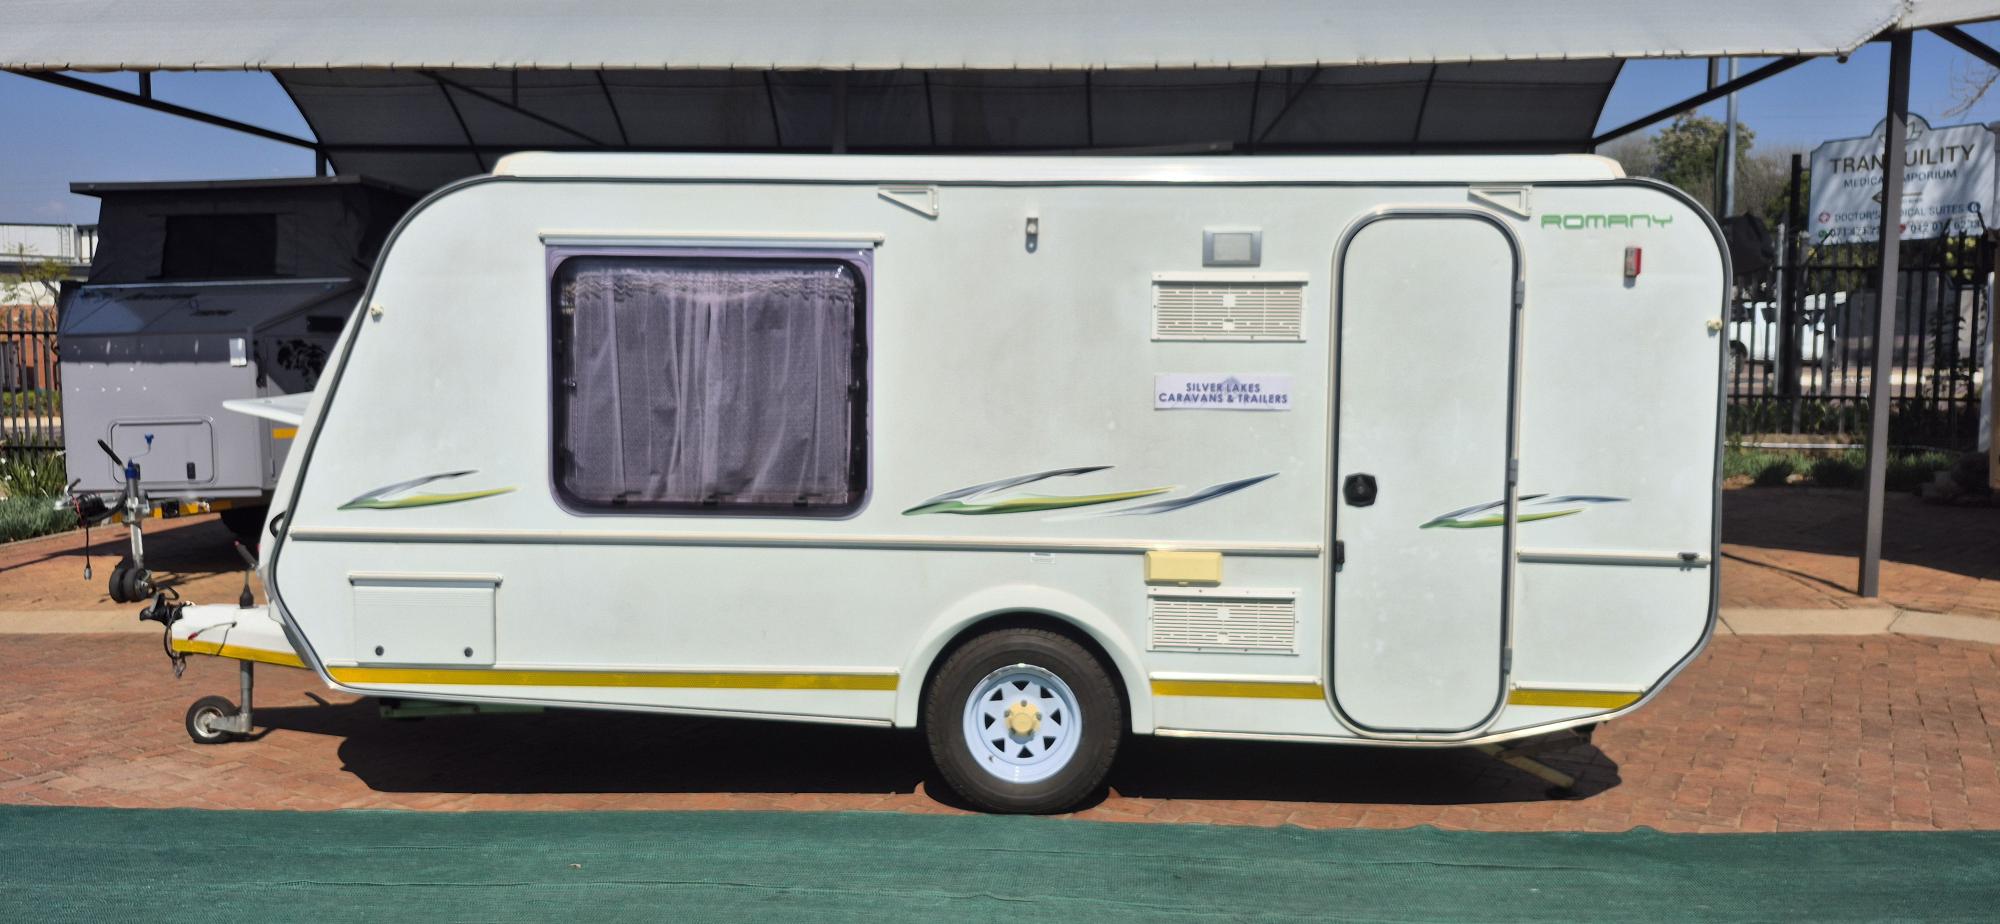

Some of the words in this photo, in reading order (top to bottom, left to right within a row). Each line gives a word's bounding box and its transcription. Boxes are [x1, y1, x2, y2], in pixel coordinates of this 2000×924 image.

[1829, 144, 1975, 174] TRANUILITY
[1843, 175, 1885, 189] MEDICA
[1903, 169, 1957, 182] MPORIUM
[1929, 204, 1964, 216] SUITES
[1541, 214, 1673, 229] ROMANY
[1185, 382, 1222, 393] SILVER
[1226, 383, 1261, 393] LAKES
[1158, 393, 1223, 403] CARAVANS
[1225, 394, 1234, 403] &
[1238, 394, 1288, 404] TRAILERS
